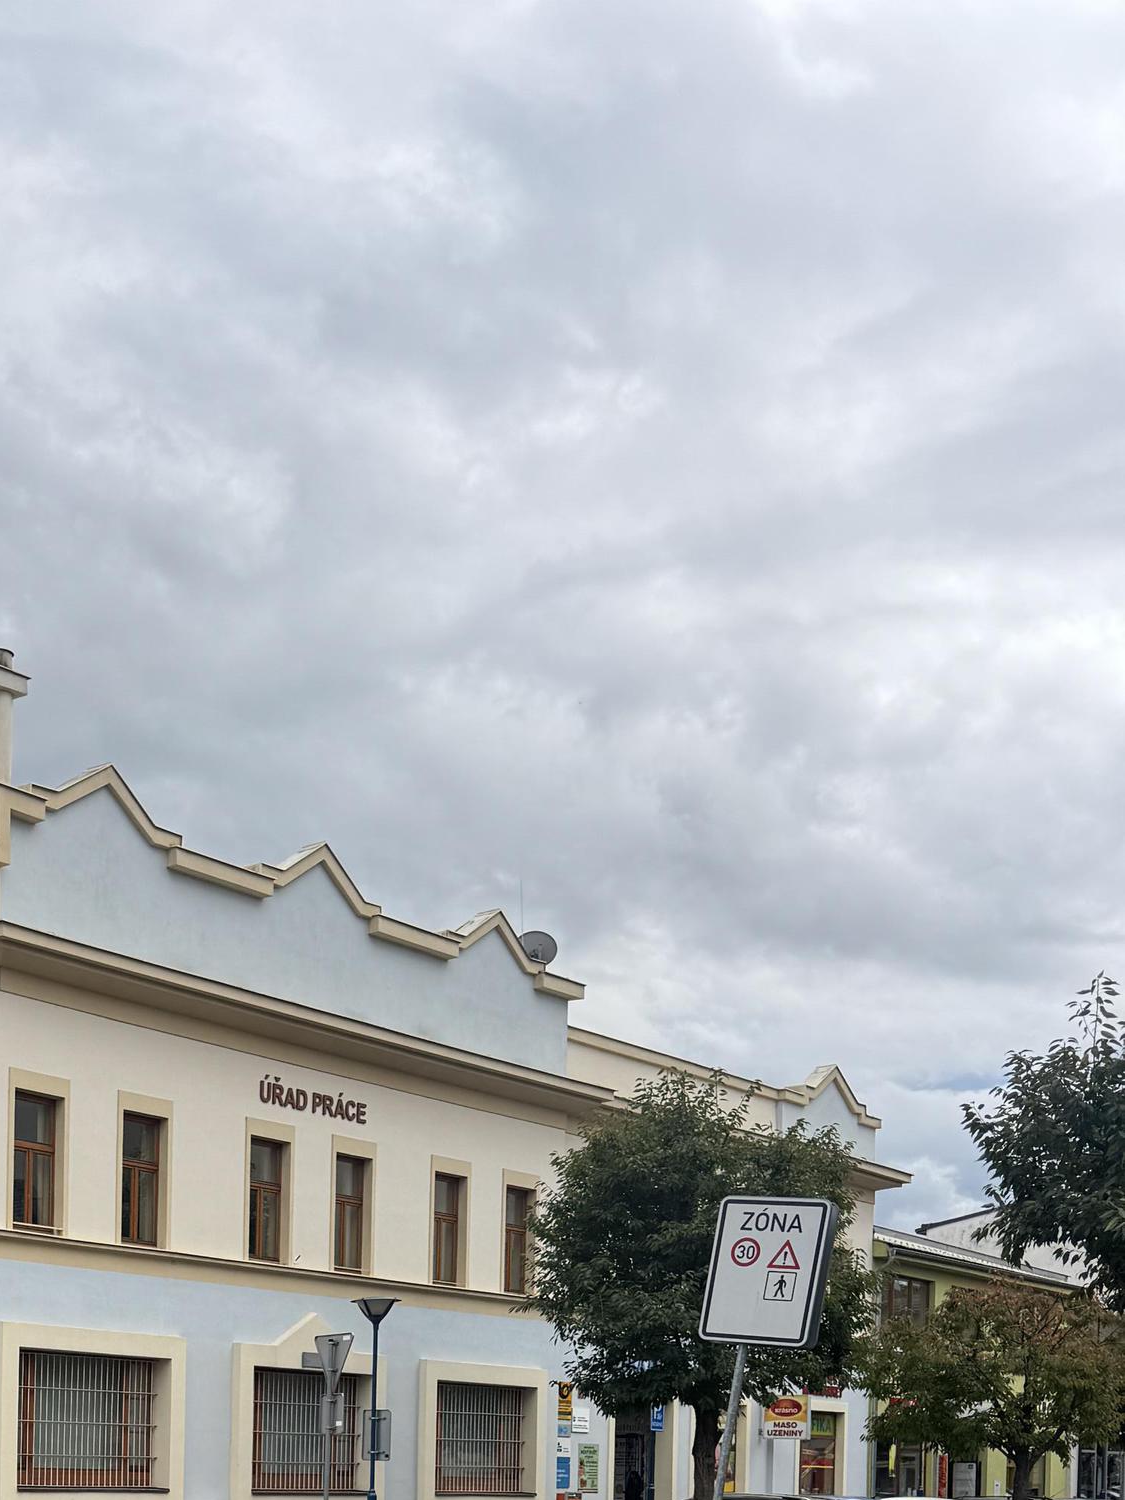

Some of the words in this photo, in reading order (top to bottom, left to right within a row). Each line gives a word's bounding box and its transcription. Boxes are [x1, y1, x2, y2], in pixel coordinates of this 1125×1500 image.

[259, 1074, 308, 1111] ÚŘAD
[312, 1092, 367, 1125] PRÁCE
[740, 1207, 803, 1233] ZÓNA
[736, 1245, 755, 1260] 30
